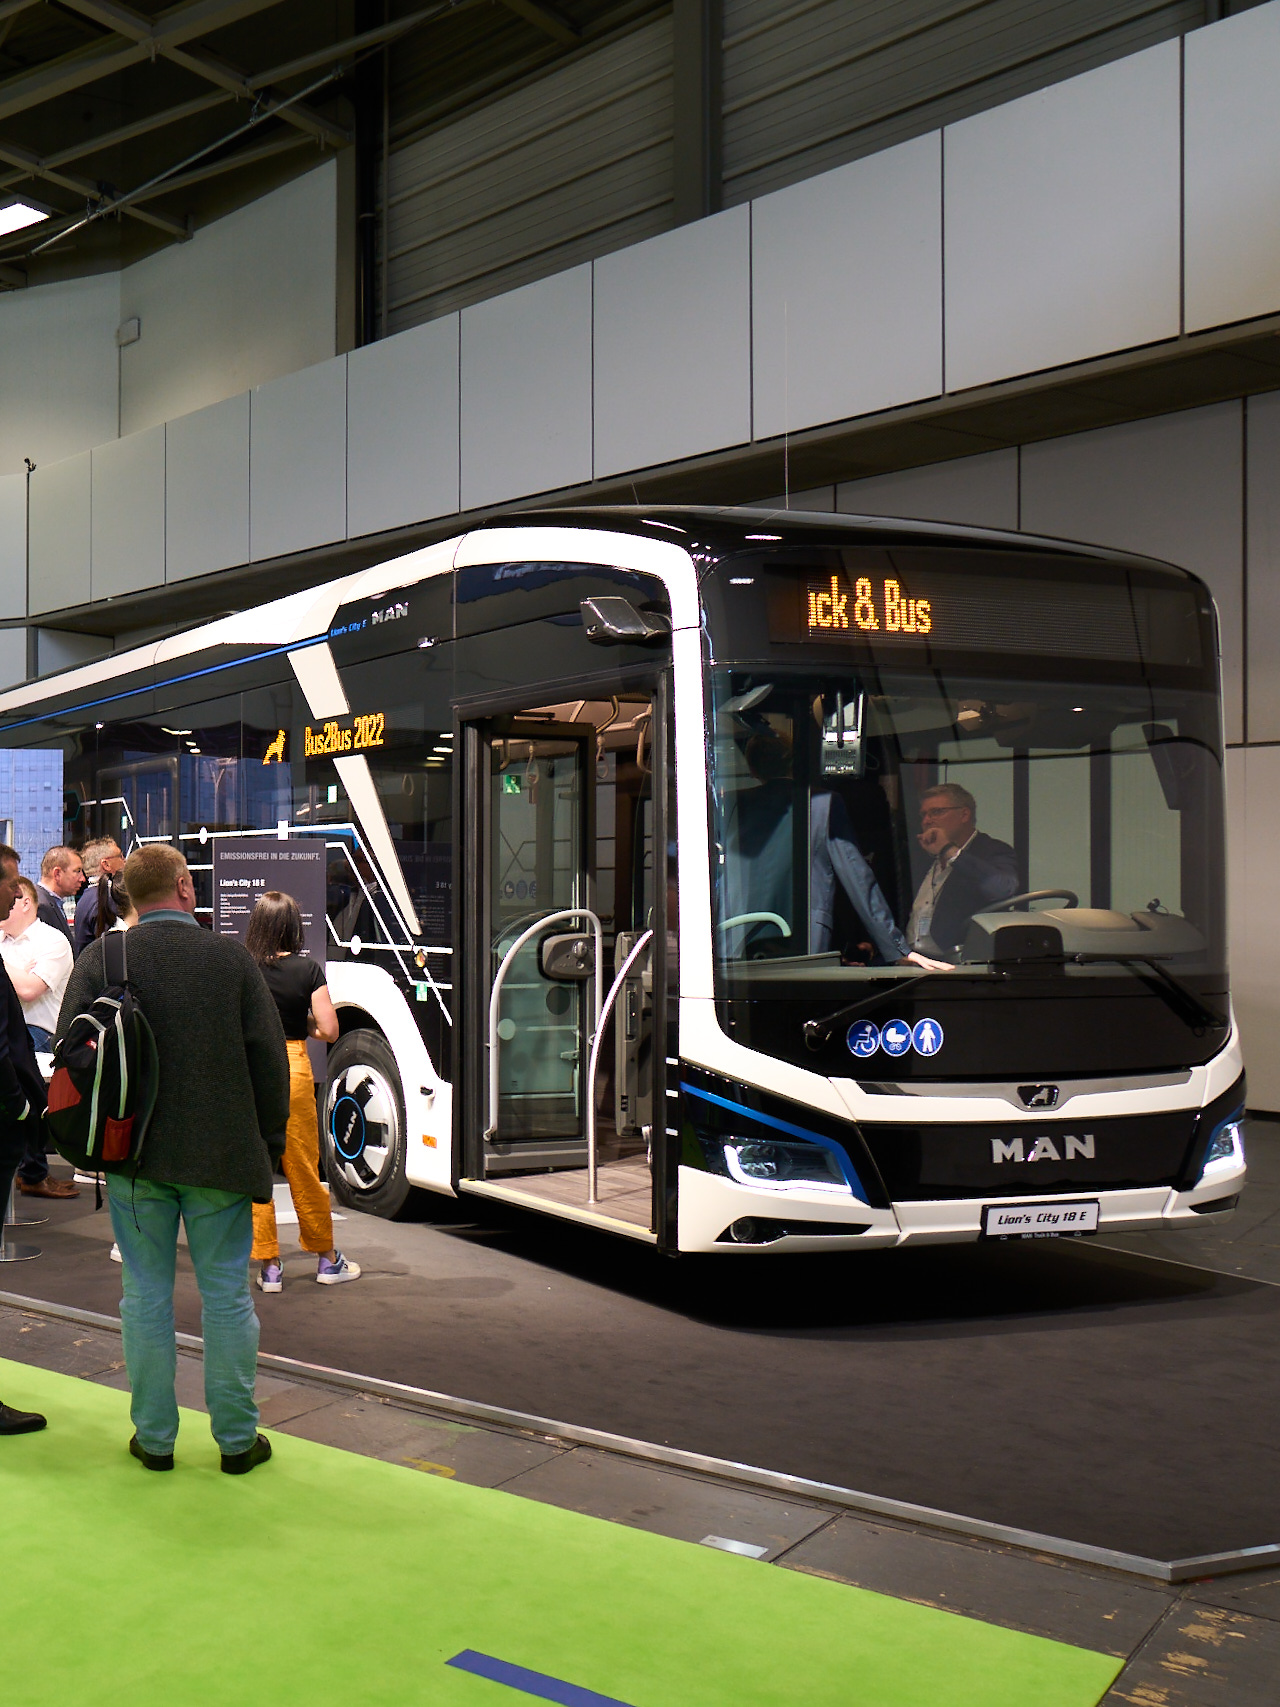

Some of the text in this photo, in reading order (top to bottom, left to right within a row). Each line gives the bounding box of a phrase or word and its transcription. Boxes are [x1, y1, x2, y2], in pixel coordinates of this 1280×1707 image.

[371, 601, 409, 625] MAN
[854, 577, 880, 630] &
[884, 579, 932, 634] Bus
[348, 622, 361, 632] City
[304, 712, 385, 757] Bus2Bus 2022
[220, 852, 270, 860] EMISSIONSFREI
[270, 852, 278, 860] IN
[279, 852, 290, 860] DIE
[220, 879, 238, 887] Lion's
[239, 879, 251, 888] City
[343, 1110, 357, 1144] MAN
[990, 1134, 1096, 1164] MAN
[998, 1211, 1087, 1225] Lion's City 18 E
